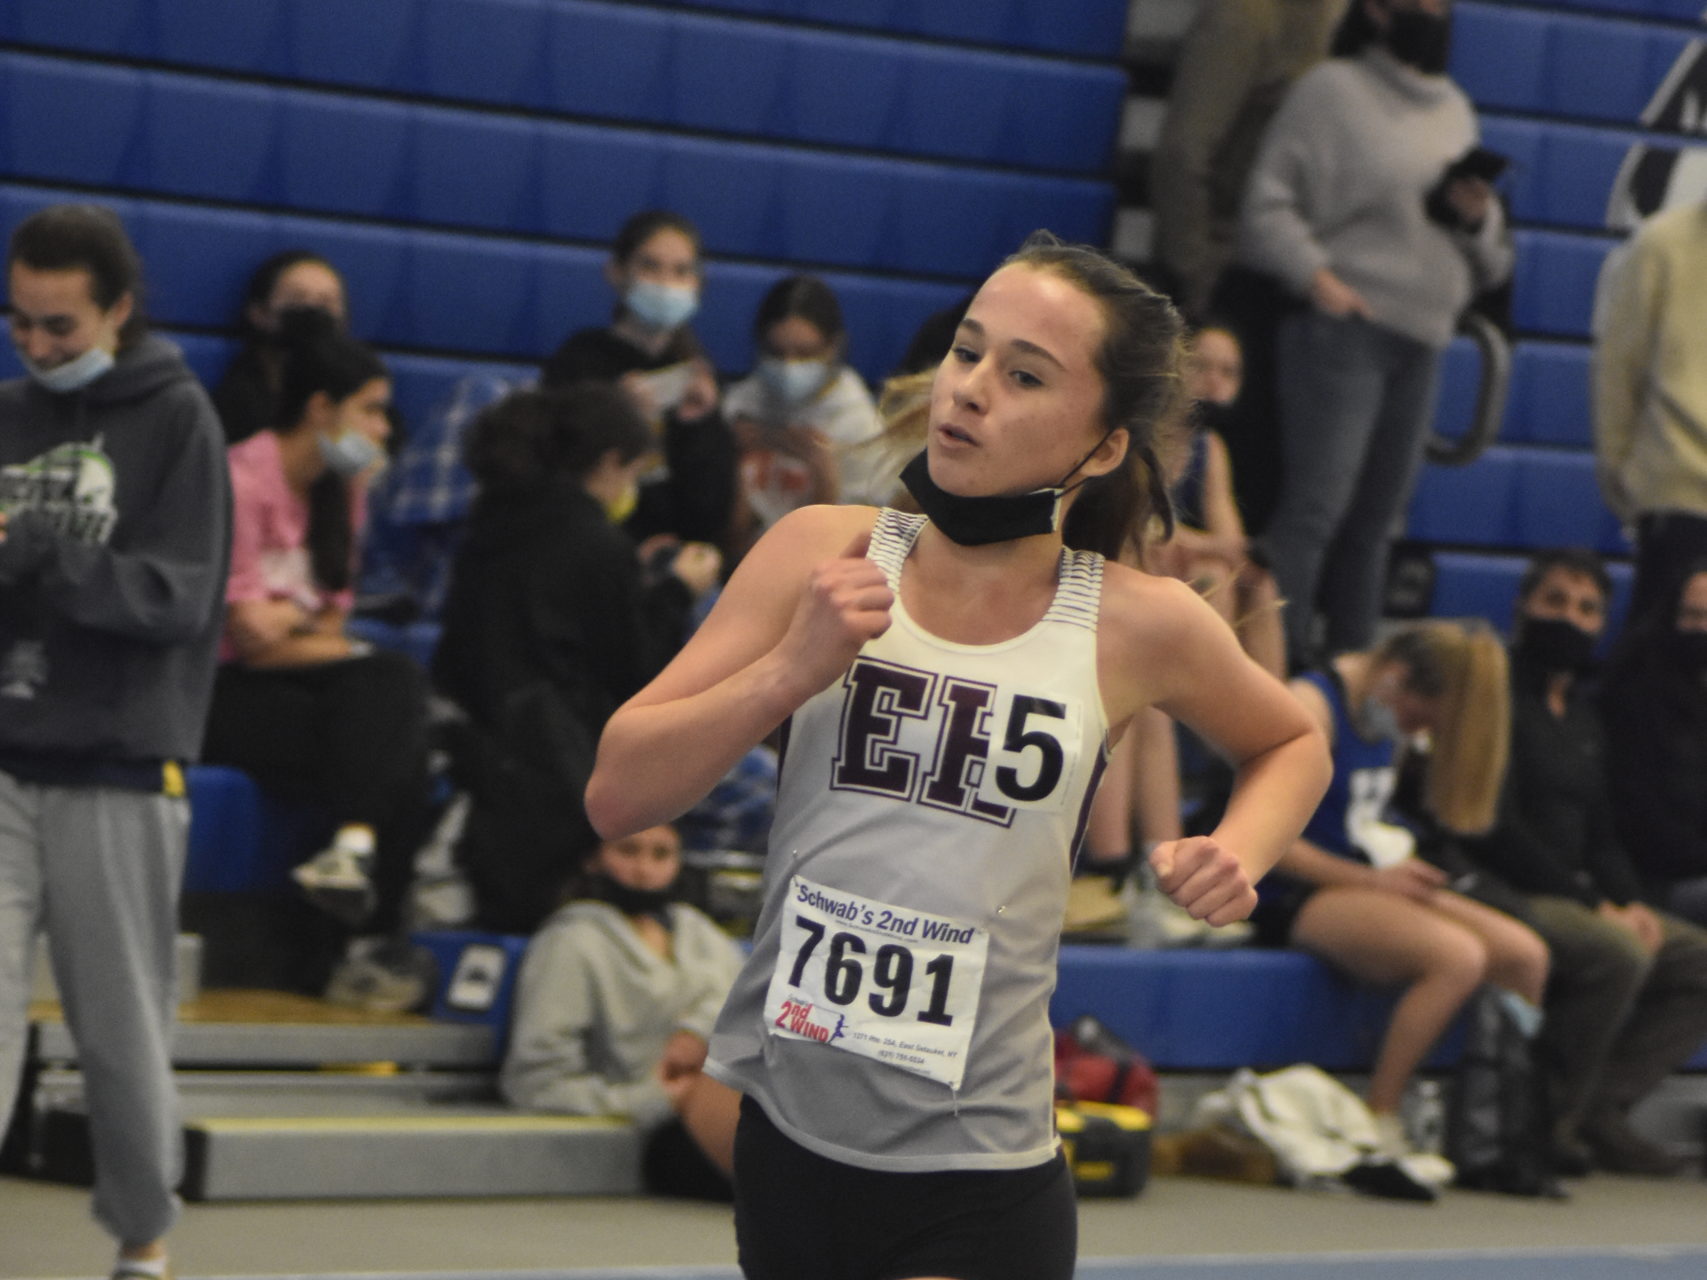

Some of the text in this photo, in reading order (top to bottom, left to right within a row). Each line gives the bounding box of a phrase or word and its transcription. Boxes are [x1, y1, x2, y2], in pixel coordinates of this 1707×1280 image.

[996, 694, 1067, 802] 5
[796, 884, 874, 925] Schwab's
[876, 910, 919, 936] 2nd
[922, 919, 975, 945] Wind
[788, 914, 954, 1027] 7691
[775, 1001, 813, 1027] 2nd
[790, 1017, 829, 1043] WIND
